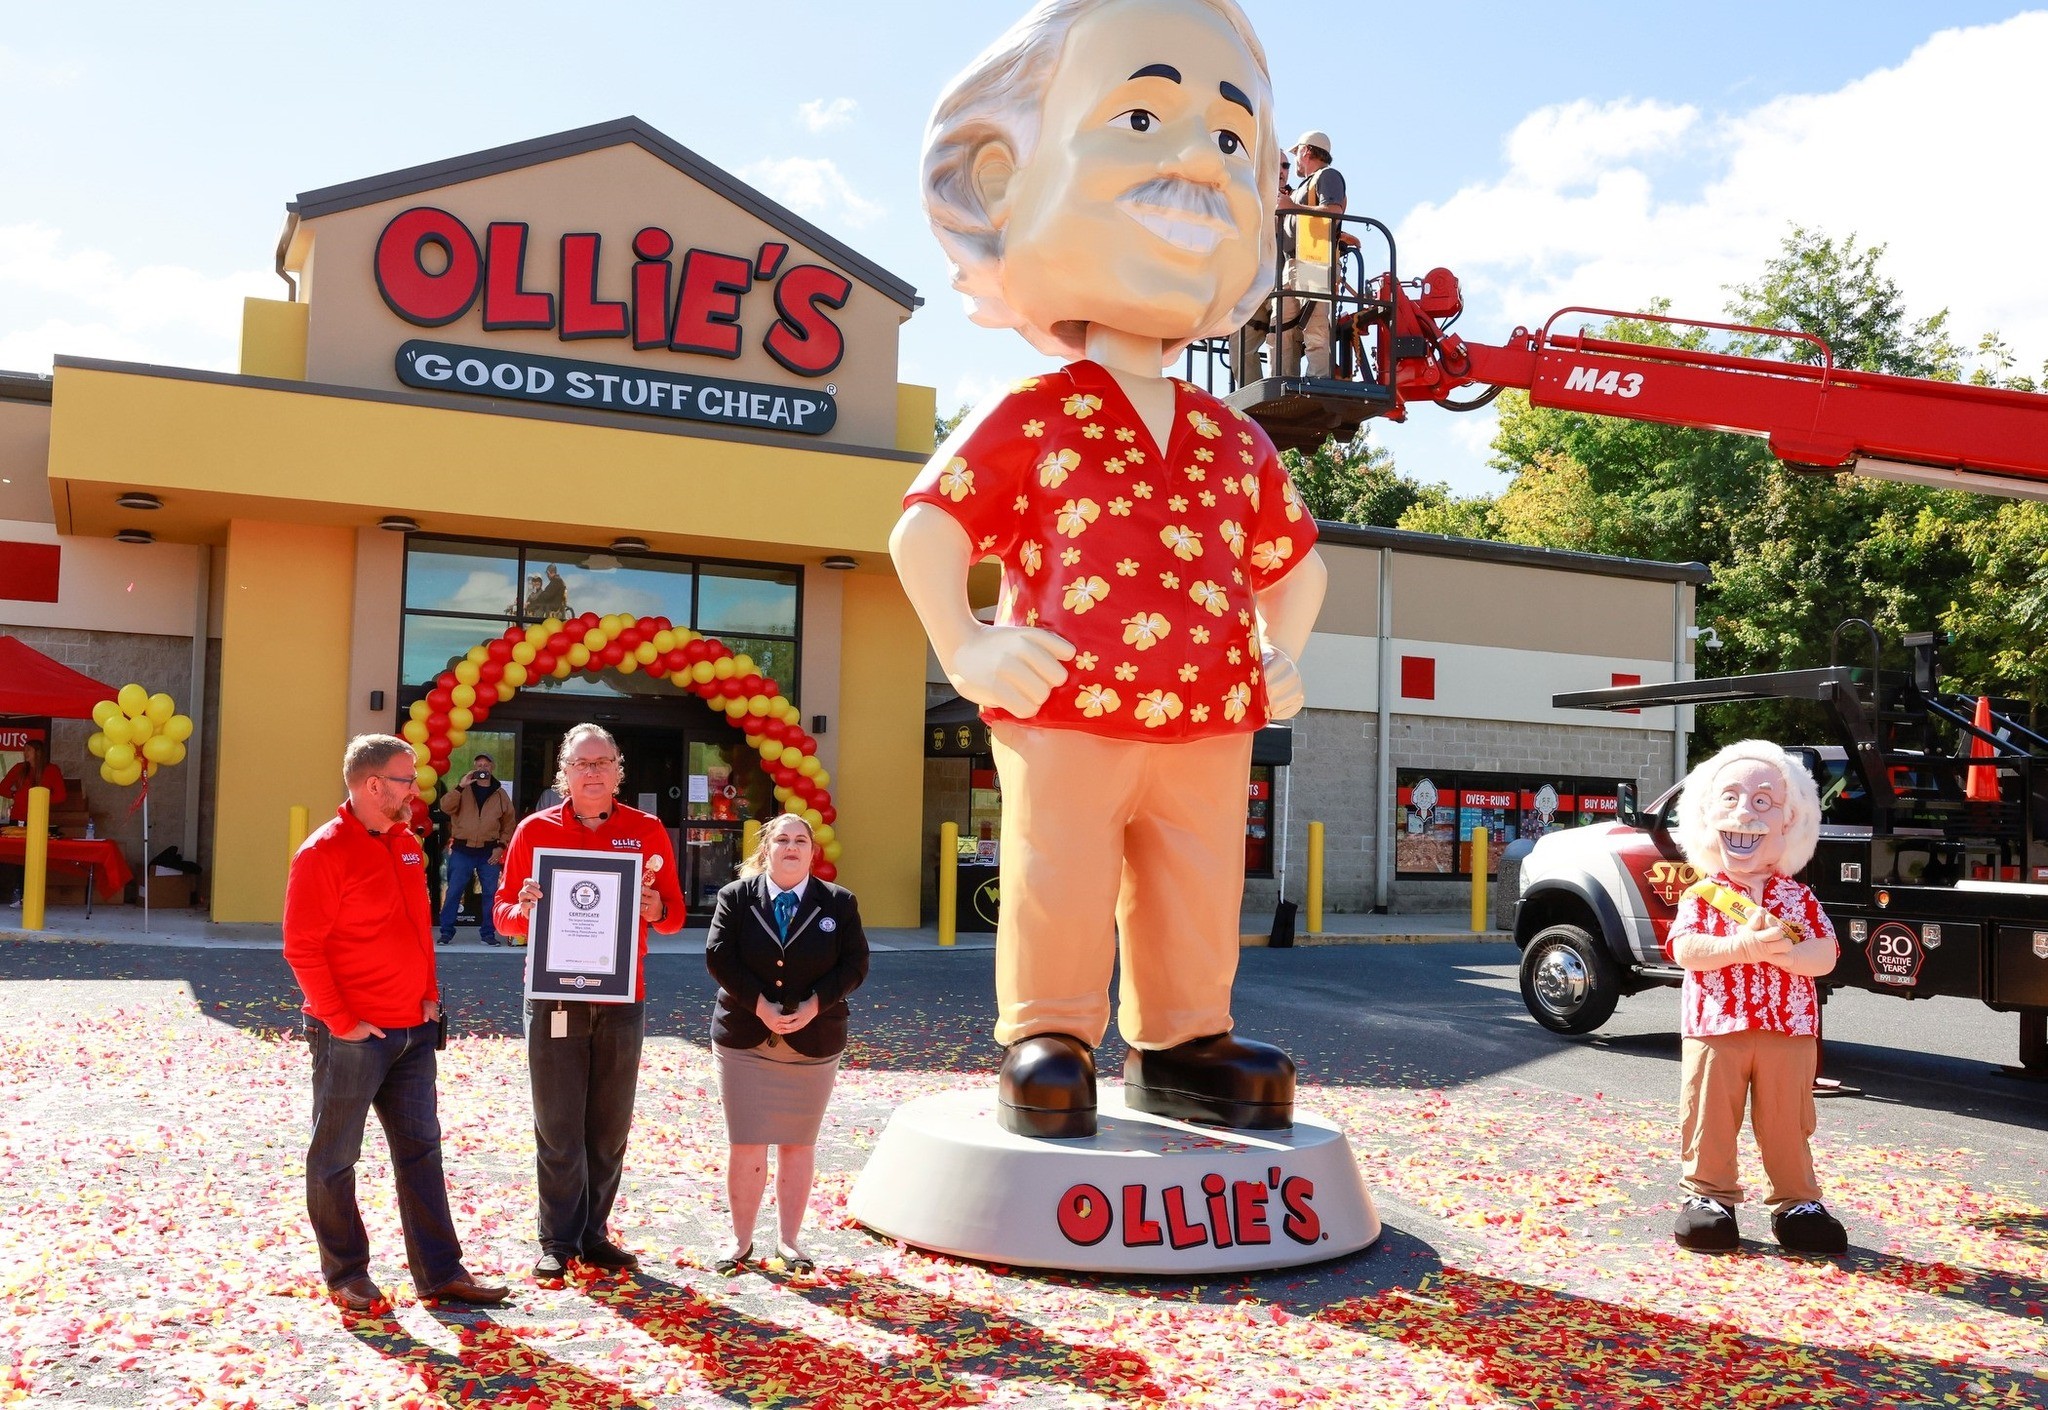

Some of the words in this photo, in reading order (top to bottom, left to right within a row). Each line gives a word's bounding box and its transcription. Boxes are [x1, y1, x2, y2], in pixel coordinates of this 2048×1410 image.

[1564, 366, 1644, 398] M43
[565, 371, 693, 411] STUFF
[1466, 793, 1510, 807] OVER-RUNS
[1584, 798, 1598, 810] BUY
[569, 911, 600, 919] CERTIFICATE
[1879, 934, 1912, 956] 30
[1877, 955, 1911, 966] CREATIVE
[1883, 964, 1907, 974] YEARS
